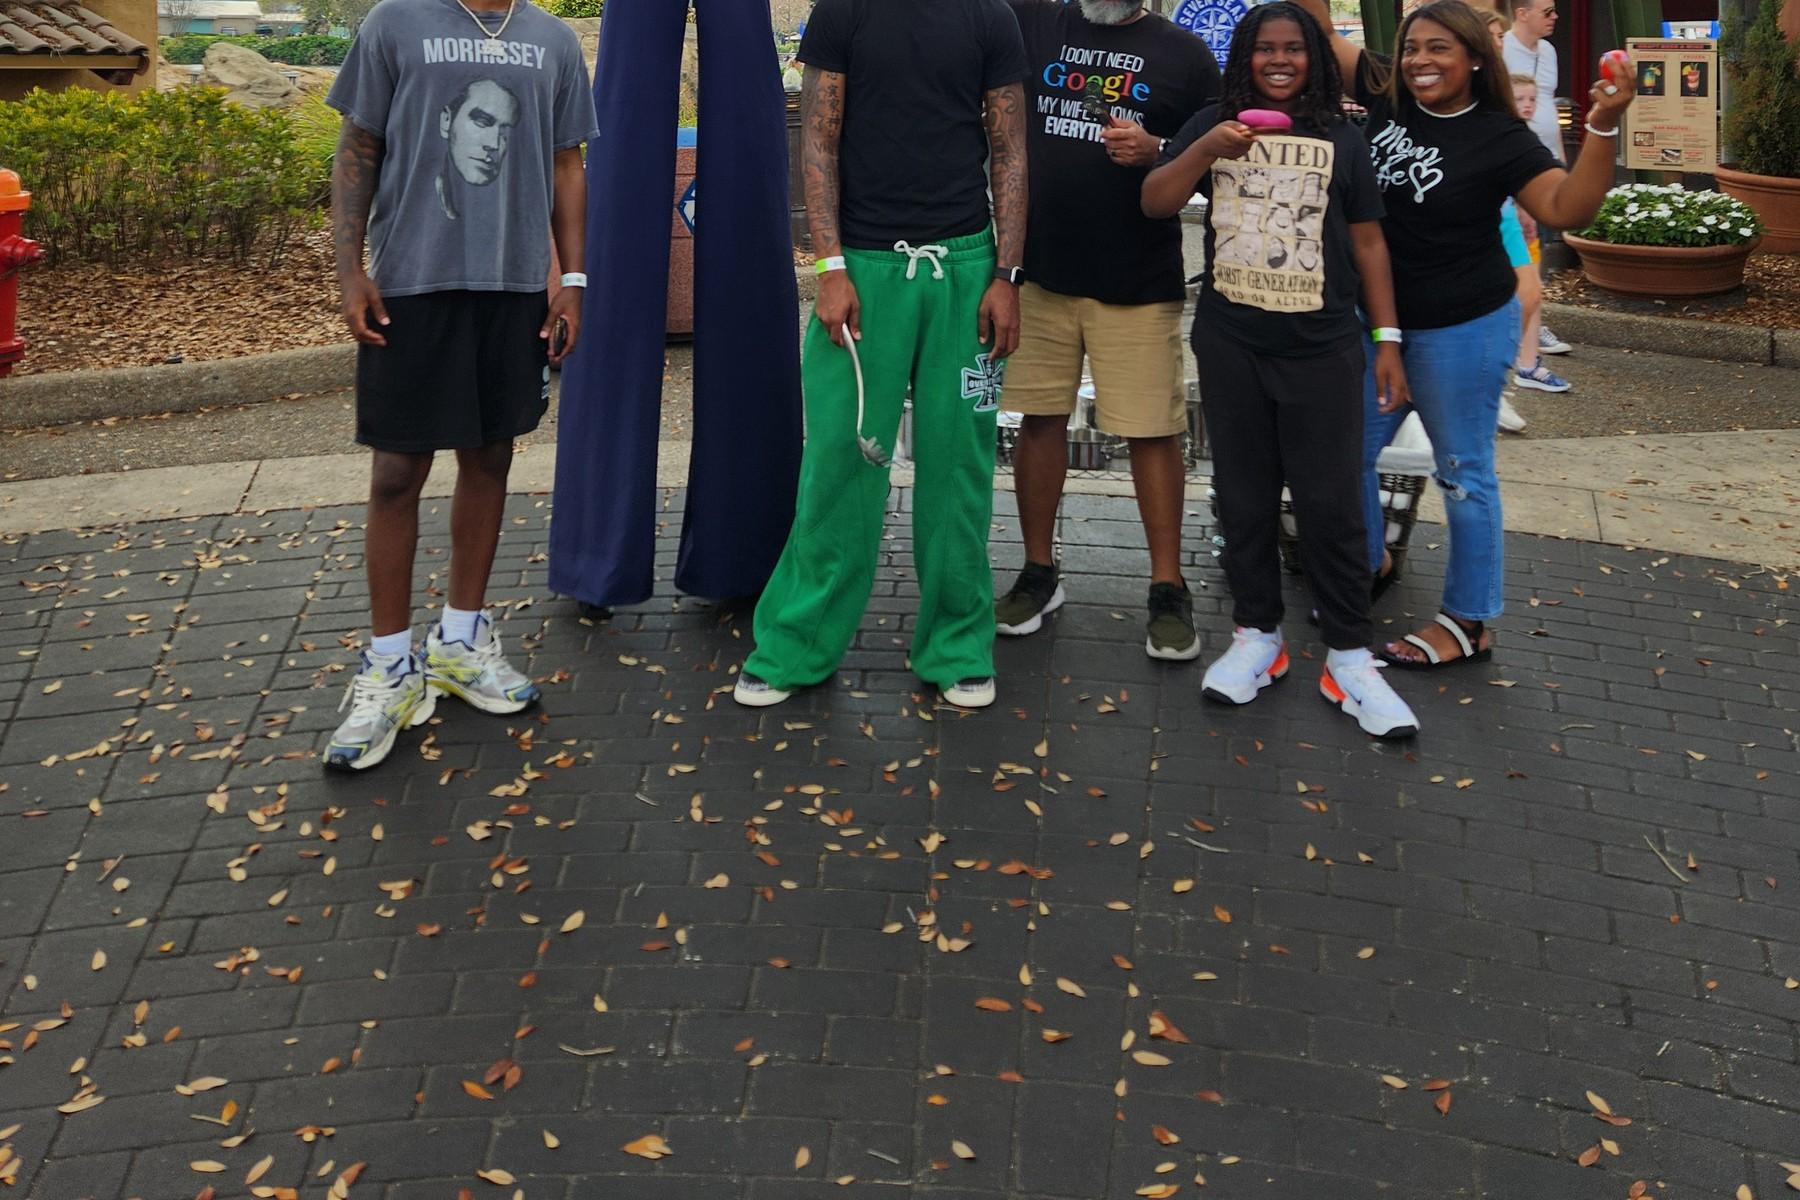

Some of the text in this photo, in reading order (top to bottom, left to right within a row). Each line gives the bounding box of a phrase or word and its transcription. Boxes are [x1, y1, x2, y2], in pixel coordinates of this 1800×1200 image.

[1060, 45, 1144, 73] I DON'T NEED
[1037, 95, 1058, 115] MY
[1244, 140, 1329, 169] NTED
